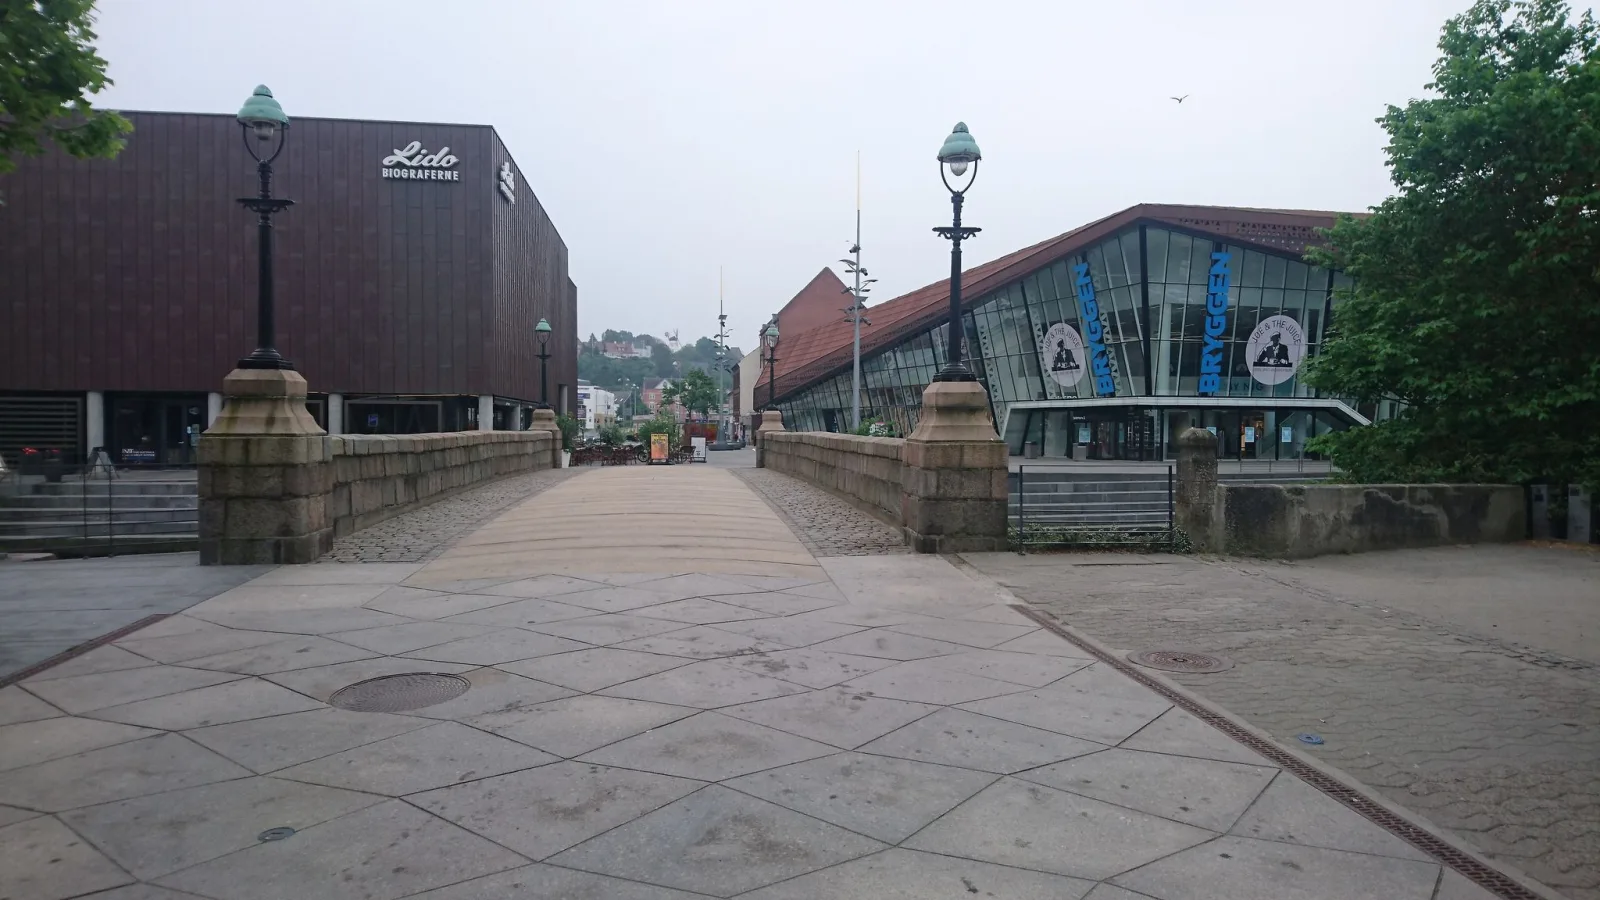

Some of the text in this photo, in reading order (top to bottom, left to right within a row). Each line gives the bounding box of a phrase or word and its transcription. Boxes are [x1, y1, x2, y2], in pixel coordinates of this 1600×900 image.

[382, 141, 460, 167] Lido
[382, 167, 459, 181] BIOGRAFERNE
[1073, 262, 1115, 394] BRYGGEN
[1198, 252, 1233, 393] BRYGGEN
[1264, 322, 1270, 330] &
[1272, 320, 1286, 328] THE
[1286, 325, 1301, 346] JUICE
[1066, 330, 1080, 347] JUICE
